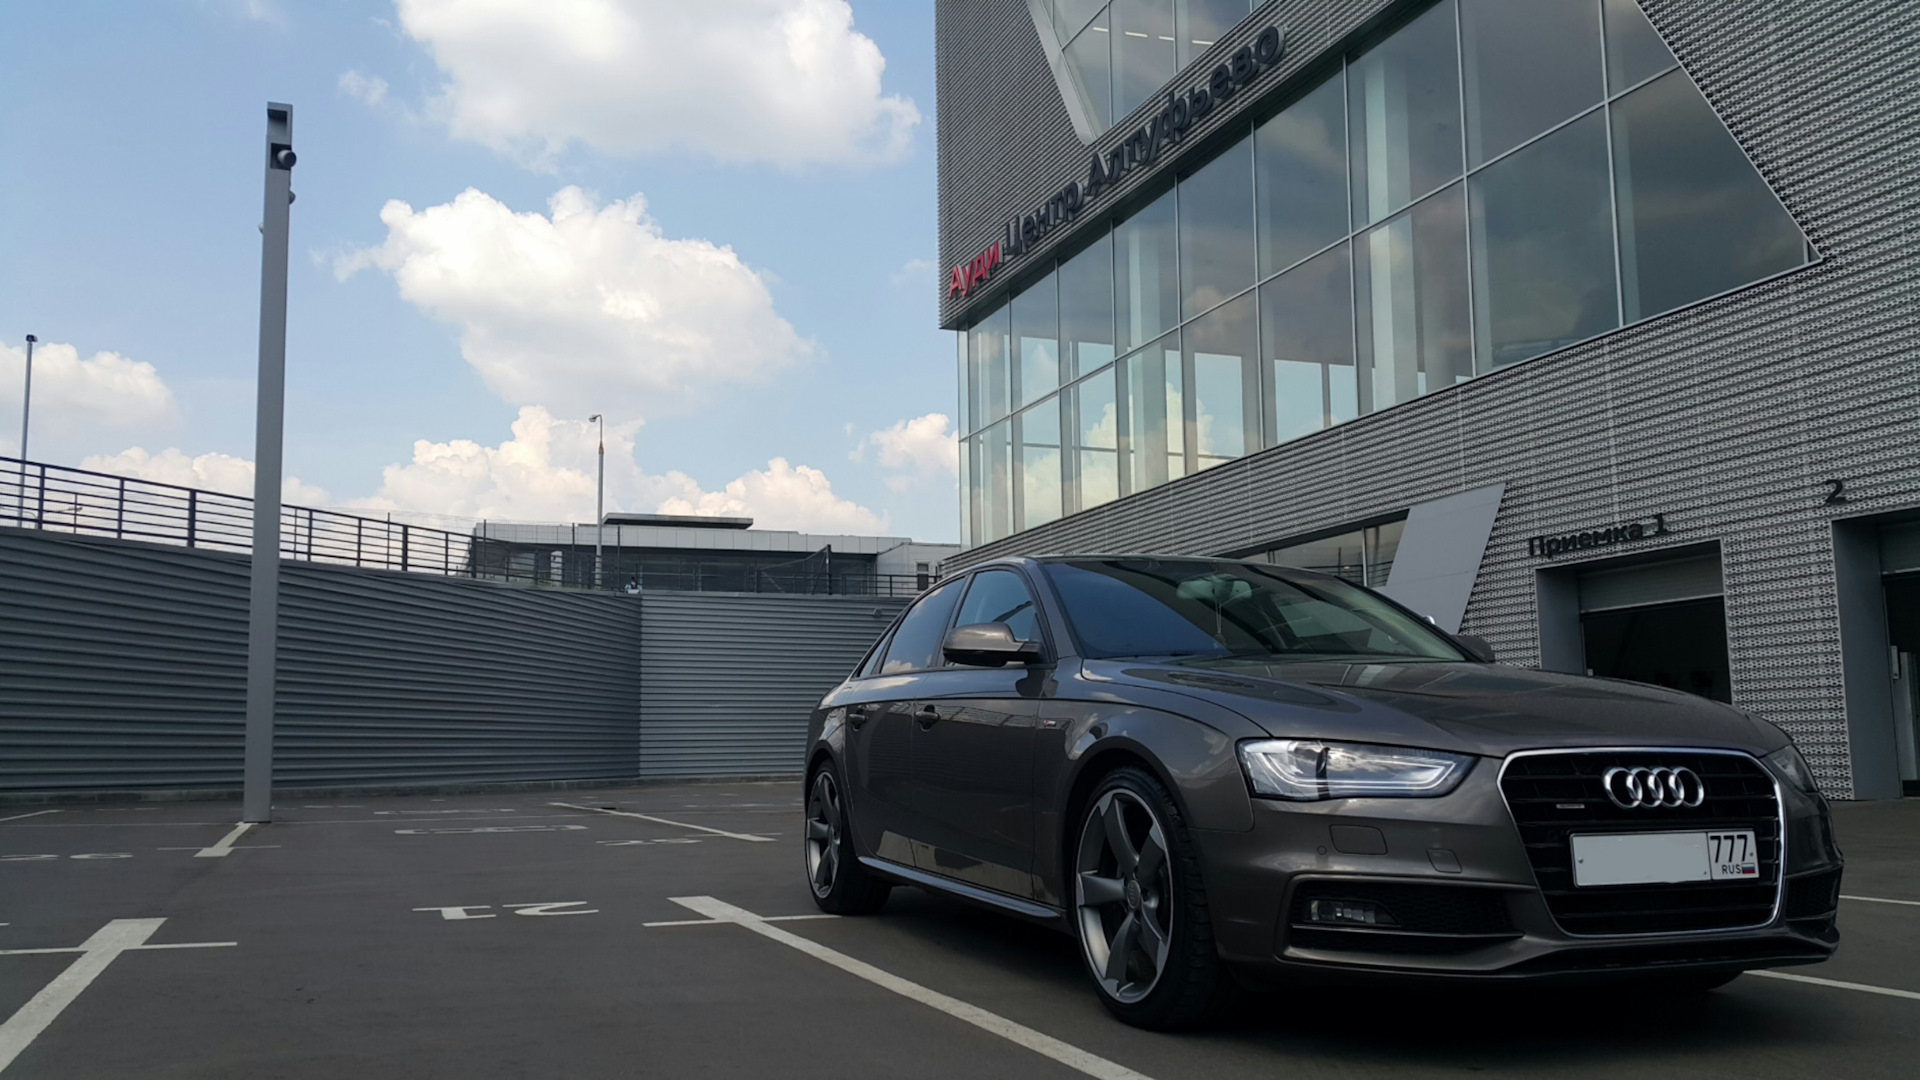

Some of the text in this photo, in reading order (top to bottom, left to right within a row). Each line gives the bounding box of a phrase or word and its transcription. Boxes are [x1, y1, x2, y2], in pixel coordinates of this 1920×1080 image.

[948, 26, 1283, 298] Ауди Центр Алтуфьево
[1825, 479, 1850, 506] 2
[1528, 513, 1669, 557] Приемка 1
[1709, 834, 1748, 863] 777
[1721, 864, 1741, 875] RUS
